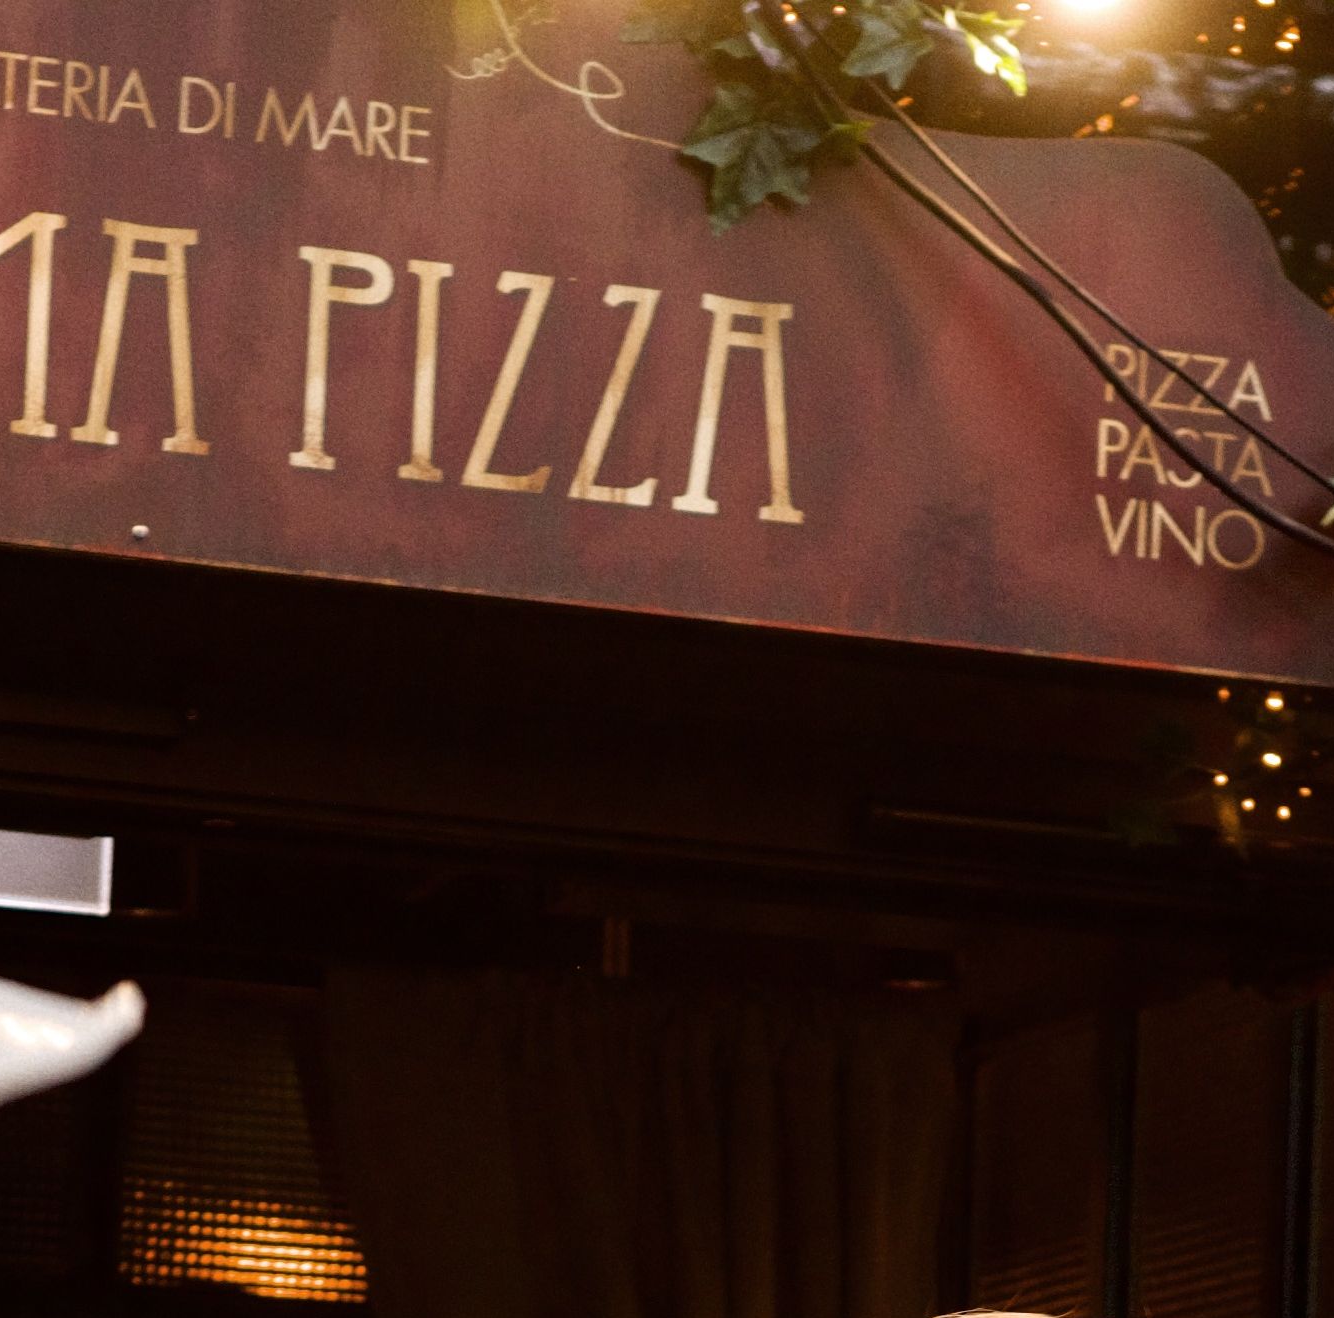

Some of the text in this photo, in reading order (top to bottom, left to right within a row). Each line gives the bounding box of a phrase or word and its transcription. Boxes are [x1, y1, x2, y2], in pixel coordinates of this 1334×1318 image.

[177, 75, 238, 139] DI
[255, 86, 433, 165] MARE
[289, 245, 805, 524] PIZZA
[1104, 343, 1273, 422] PIZZA
[1096, 418, 1273, 497] PASTA
[1095, 493, 1265, 570] VINO
